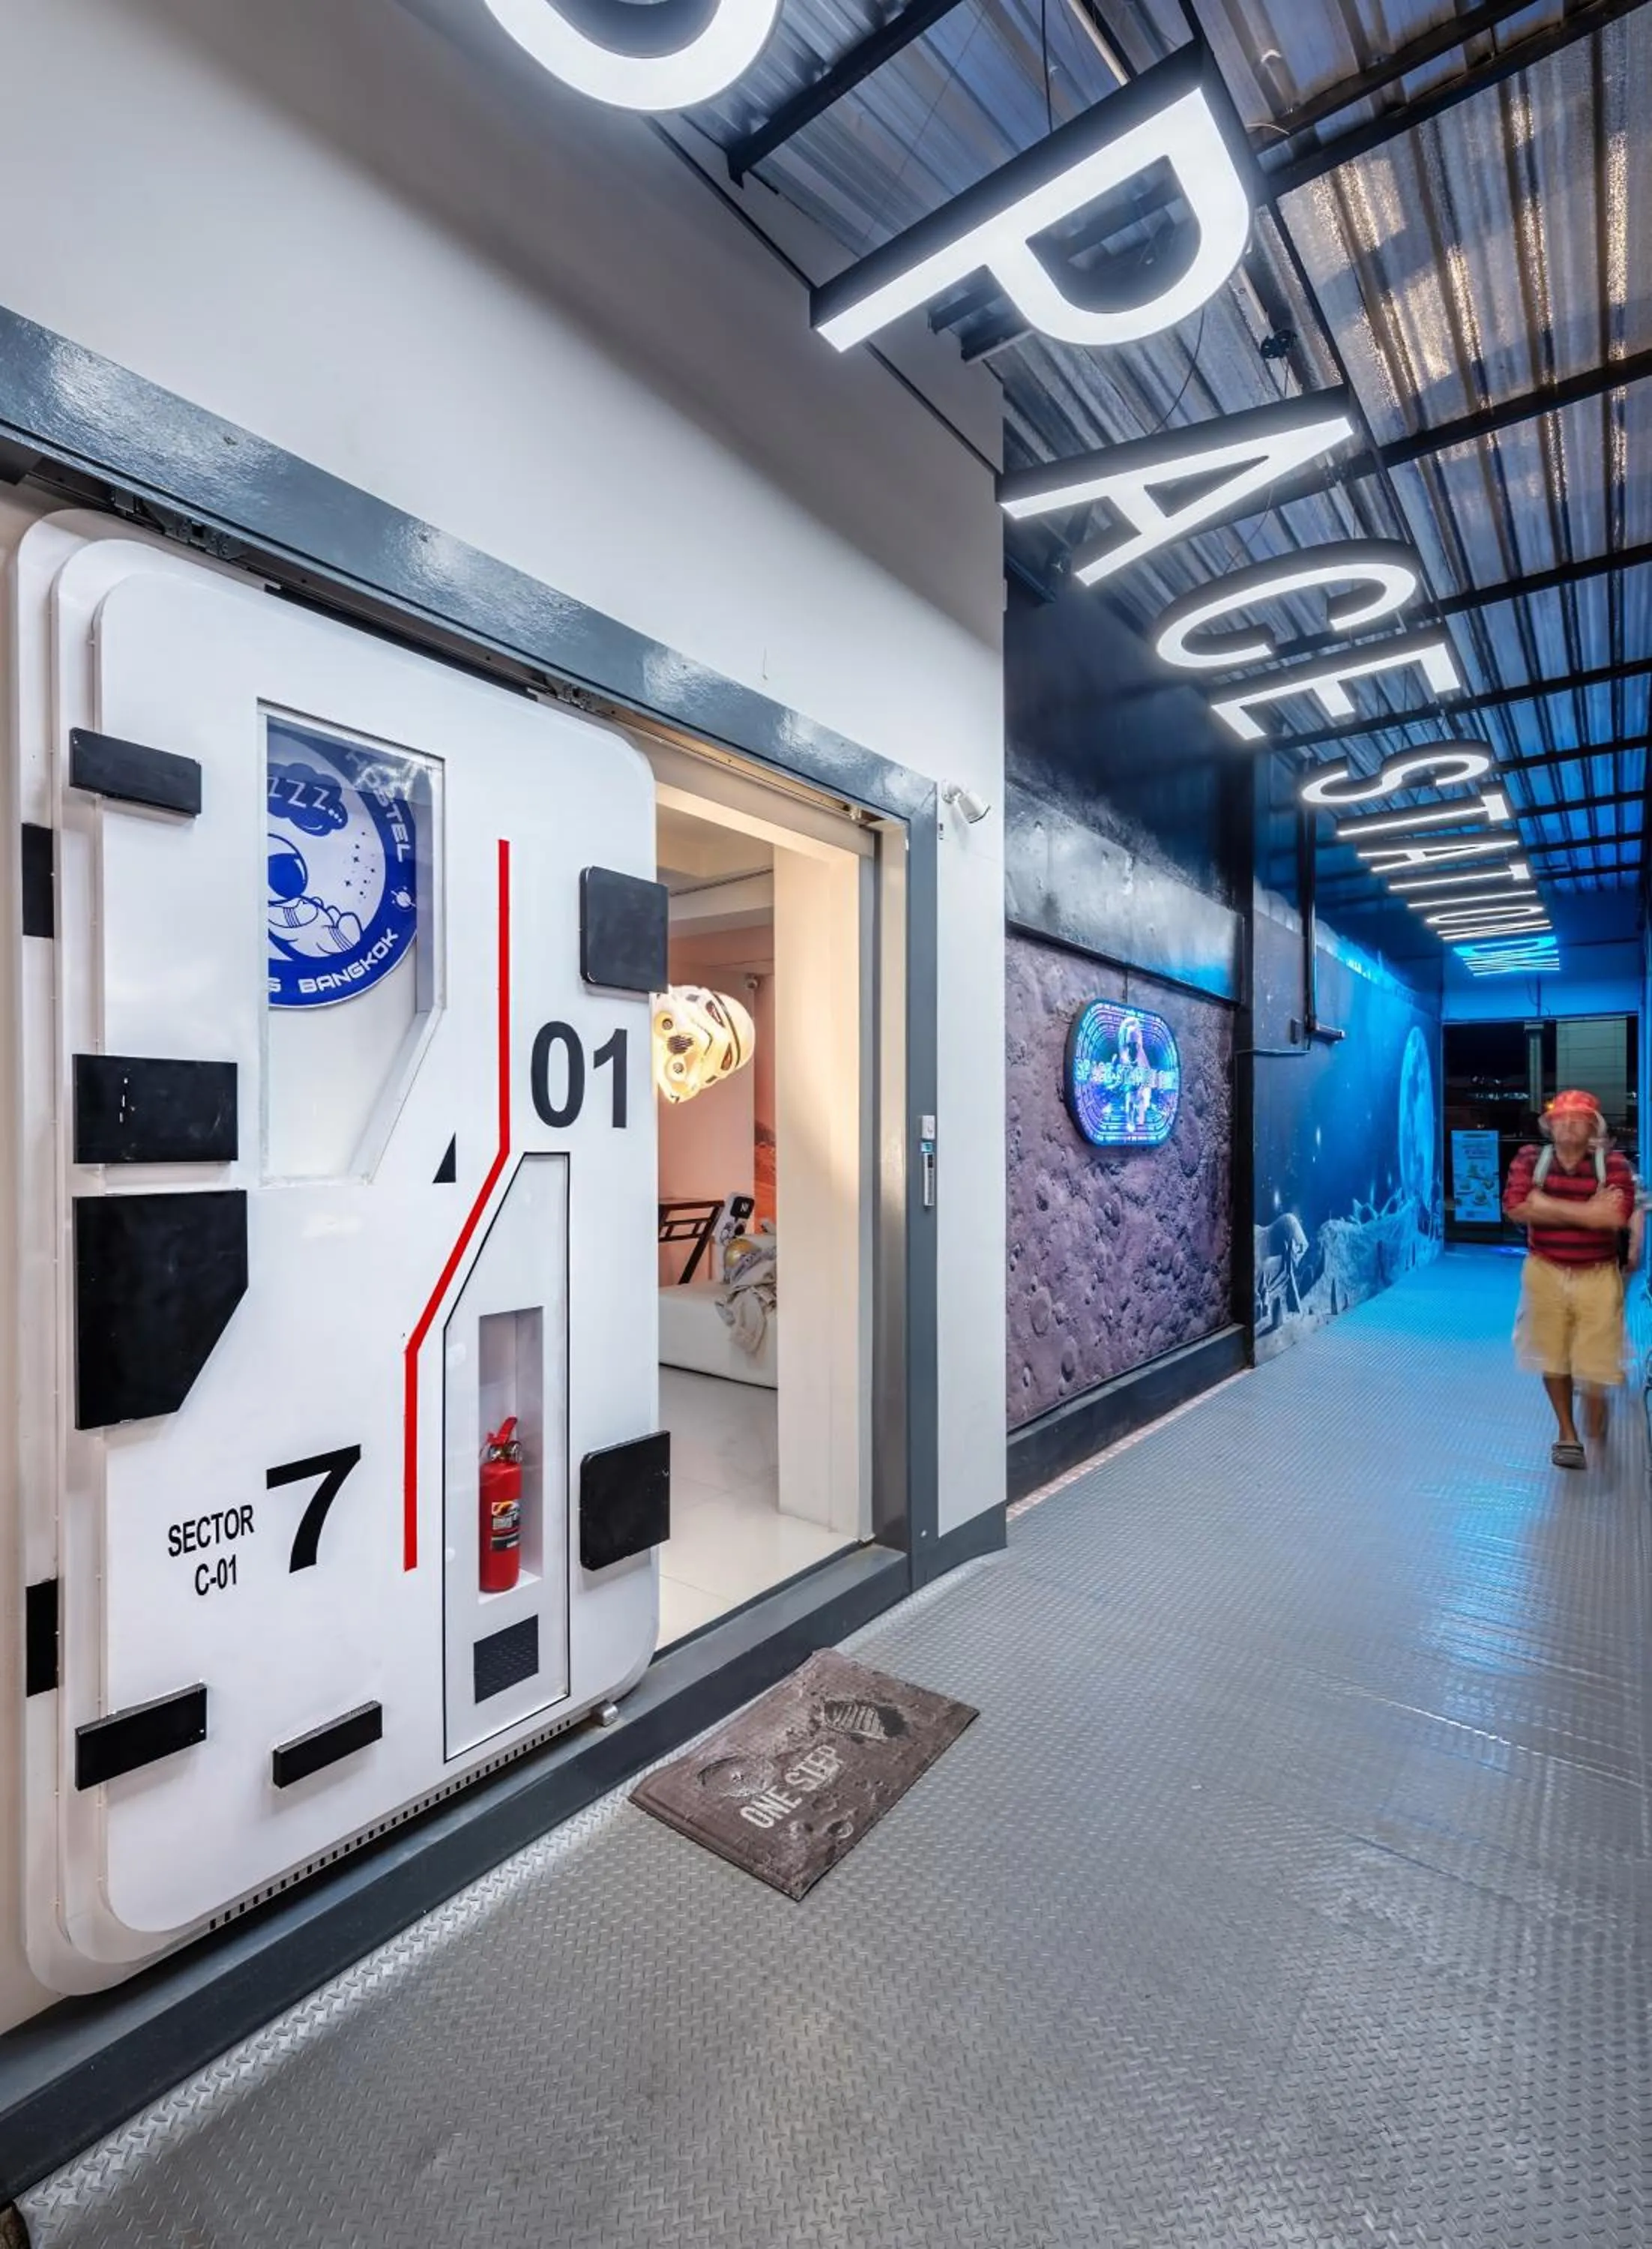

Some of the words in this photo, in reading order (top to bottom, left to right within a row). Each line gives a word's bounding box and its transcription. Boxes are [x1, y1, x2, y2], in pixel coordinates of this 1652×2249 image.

[1300, 753, 1554, 940] STATION
[298, 927, 400, 994] BANGKOK
[530, 1020, 628, 1128] 01
[167, 1504, 255, 1557] SECTOR
[266, 1444, 361, 1573] 7
[193, 1554, 238, 1596] C-01
[740, 1785, 803, 1828] ONE
[784, 1744, 844, 1792] STEP
